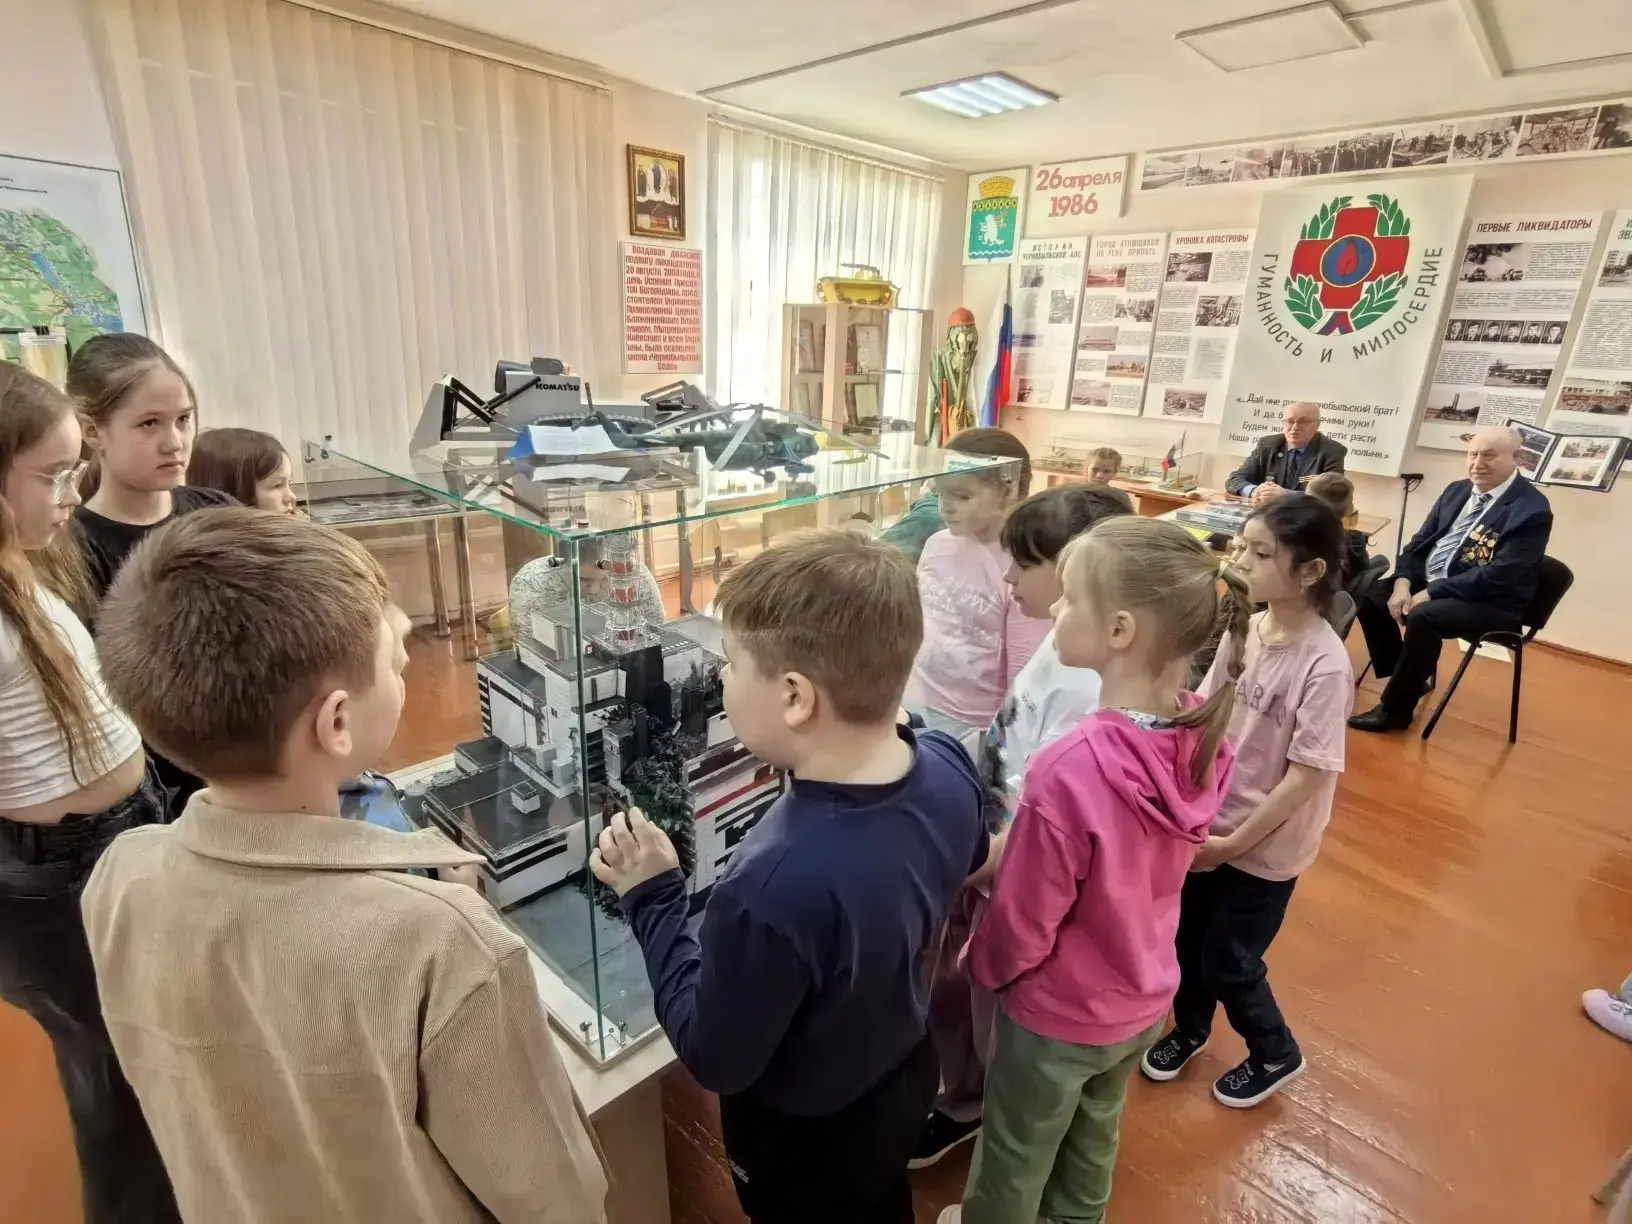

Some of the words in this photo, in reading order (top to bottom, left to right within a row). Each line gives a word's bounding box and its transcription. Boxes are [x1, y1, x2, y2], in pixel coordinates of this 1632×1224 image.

[1035, 168, 1062, 191] 26
[1062, 171, 1122, 191] апреля
[1048, 193, 1098, 217] 1986
[1476, 222, 1512, 233] ПЕРВЫЕ
[1516, 219, 1592, 232] ЛИКВИДАТОРЫ
[1096, 240, 1116, 249] ГОРОД
[1120, 238, 1160, 247] АТОМЩИКОВ
[1176, 236, 1204, 245] ХРОНИКА
[1206, 234, 1249, 244] КАТАСТРОФЫ
[632, 245, 665, 257] Воздавая
[1032, 242, 1073, 252] ИСТОРИЯ
[1096, 249, 1104, 257] НА
[1108, 248, 1123, 257] РЕКЕ
[1023, 251, 1067, 260] ЧЕРНОБЫЛЬСКОЙ
[1070, 250, 1082, 259] АЭС
[626, 256, 653, 266] подвигу
[636, 267, 661, 277] августа
[664, 268, 679, 278] 2003
[627, 277, 642, 285] день
[644, 277, 671, 286] Успения
[627, 286, 638, 294] той
[627, 296, 663, 305] стоятелем
[1256, 253, 1303, 357] ГУМАННОСТЬ
[1320, 348, 1333, 363] И
[1353, 248, 1443, 360] МИЛОСЕРДИЕ
[627, 305, 672, 315] Православной
[627, 334, 661, 342] Киевским
[645, 344, 662, 352] была
[536, 382, 579, 391] KOMATSU
[1265, 398, 1280, 406] мне
[1373, 404, 1399, 417] брат!
[1253, 408, 1261, 417] И
[1263, 410, 1275, 419] да
[1348, 418, 1376, 430] руки!
[1229, 432, 1249, 443] Наша
[1242, 421, 1268, 432] Будем
[1350, 432, 1377, 444] расти
